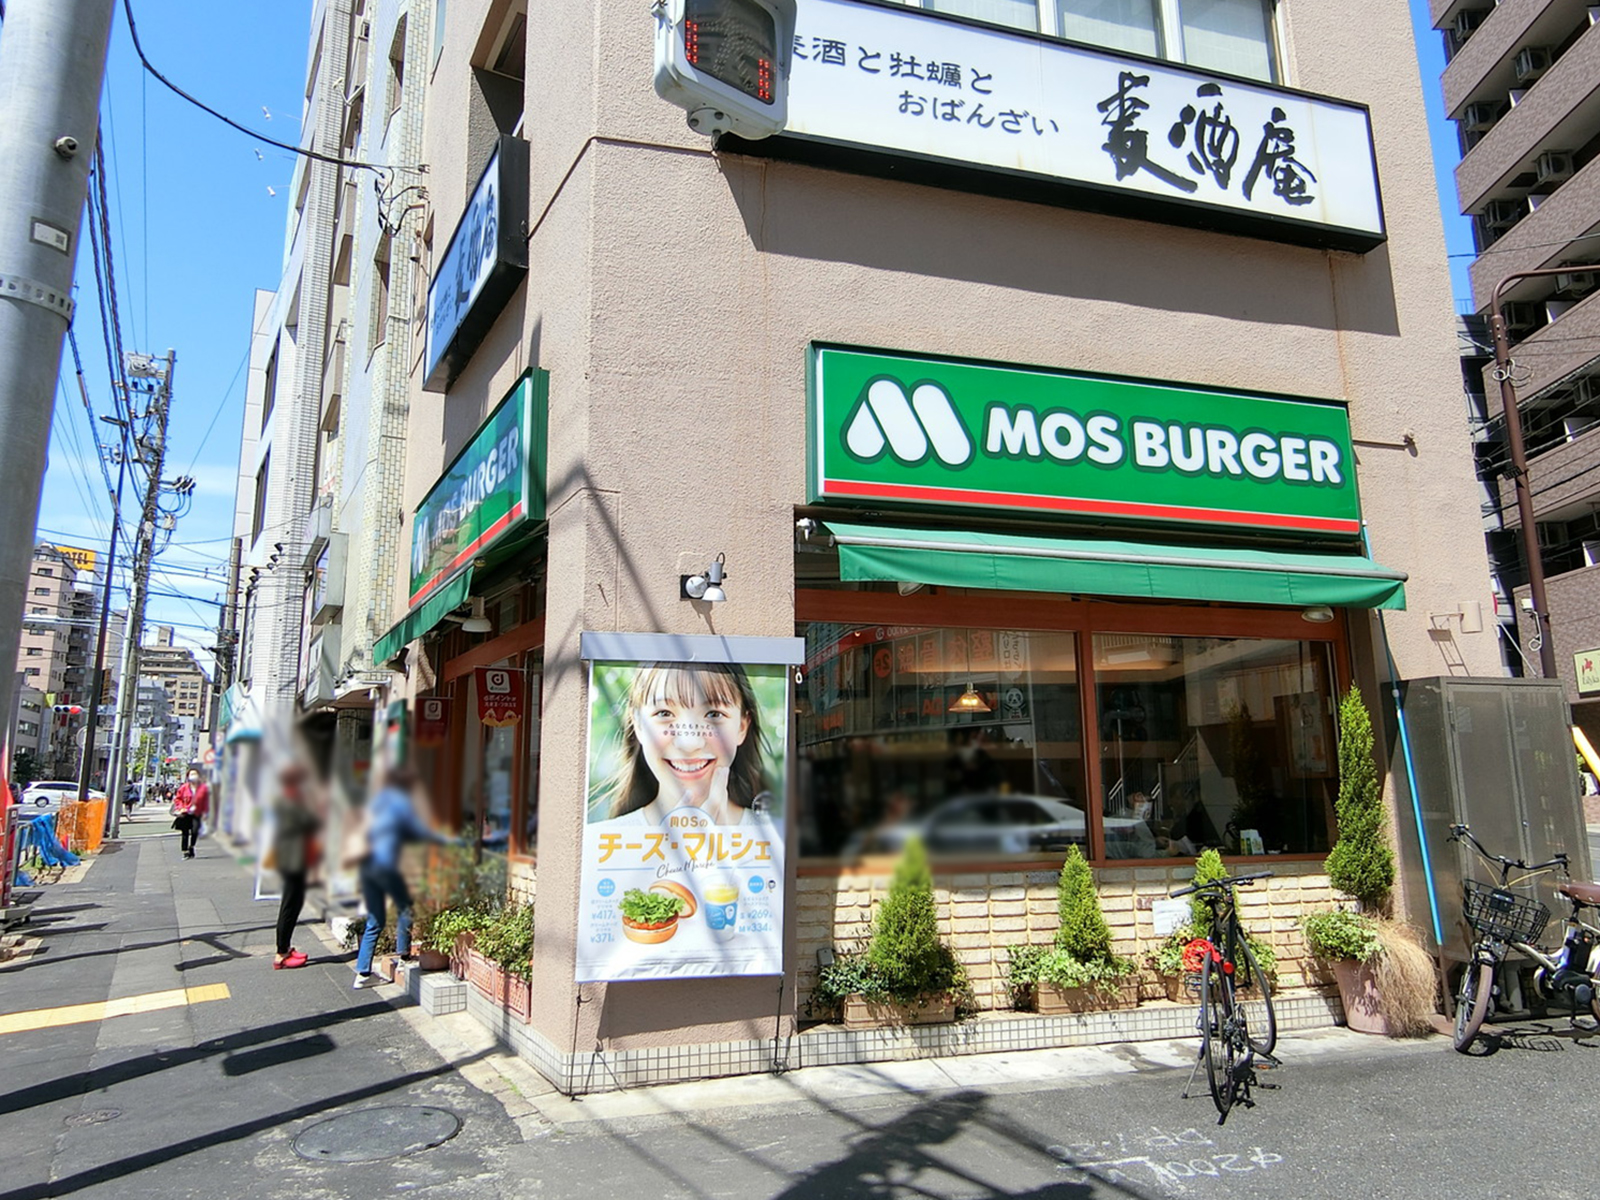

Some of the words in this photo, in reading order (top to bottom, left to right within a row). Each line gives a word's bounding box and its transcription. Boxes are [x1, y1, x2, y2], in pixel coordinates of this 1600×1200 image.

[898, 90, 1060, 136] おばんざい
[459, 426, 519, 522] BURGER
[986, 406, 1123, 465] MOS
[1133, 421, 1341, 485] BURGER
[598, 832, 771, 863] チーズ・マルシェ
